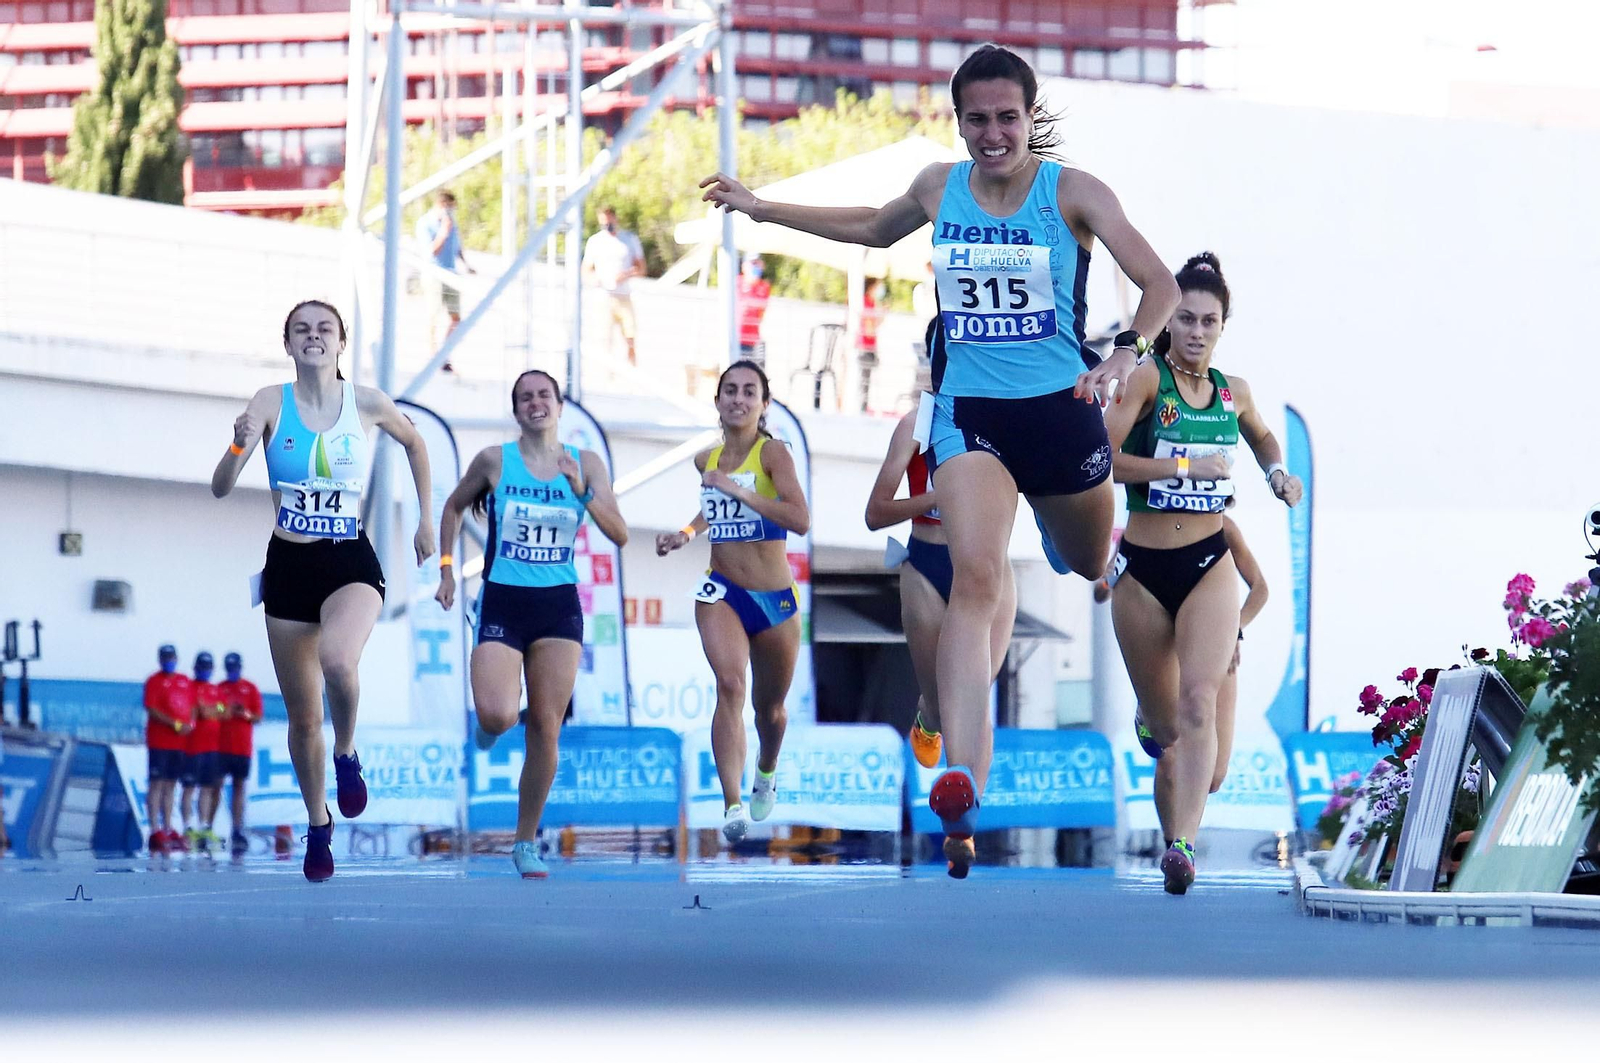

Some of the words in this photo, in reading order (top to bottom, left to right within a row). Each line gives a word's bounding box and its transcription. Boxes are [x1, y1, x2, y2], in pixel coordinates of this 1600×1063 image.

[973, 257, 986, 266] DE
[990, 257, 1032, 266] HUELVA
[957, 277, 1029, 310] 315
[294, 489, 342, 513] 314
[504, 484, 566, 504] nerja
[706, 498, 745, 521] 312
[516, 523, 557, 545] 311
[576, 767, 676, 788] HUELVA
[800, 771, 897, 791] HUELVA
[1014, 768, 1110, 790] HUELVA
